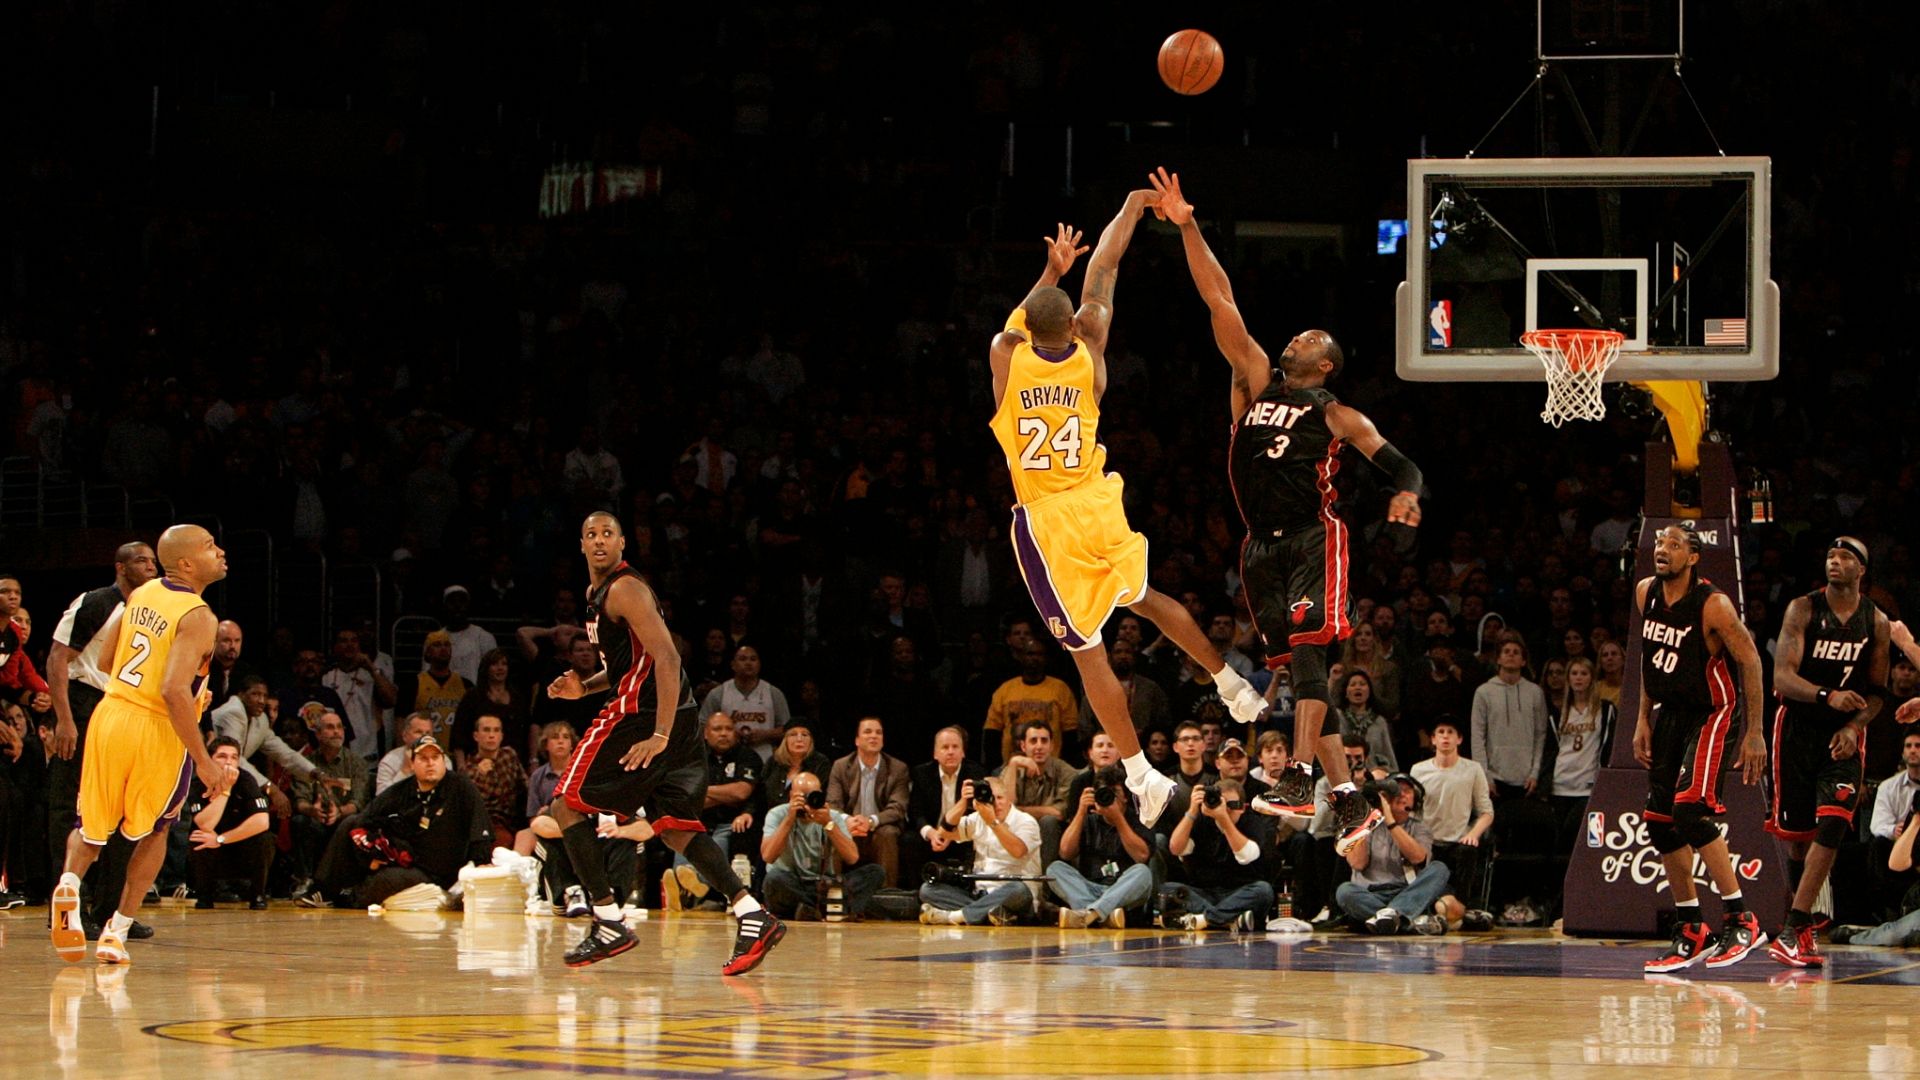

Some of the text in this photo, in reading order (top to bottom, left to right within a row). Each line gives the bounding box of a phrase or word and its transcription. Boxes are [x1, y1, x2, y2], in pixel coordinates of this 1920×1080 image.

[1019, 385, 1082, 411] BRYANT
[1244, 402, 1312, 430] HEAT
[1018, 415, 1082, 471] 24
[1267, 434, 1290, 459] 3
[129, 606, 169, 638] FISHER
[1642, 619, 1692, 649] HEAT
[117, 630, 151, 689] 2
[1652, 648, 1679, 674] 40
[1812, 637, 1869, 662] HEAT
[1840, 665, 1854, 688] 7
[1572, 734, 1583, 752] 8
[1601, 851, 1633, 883] of
